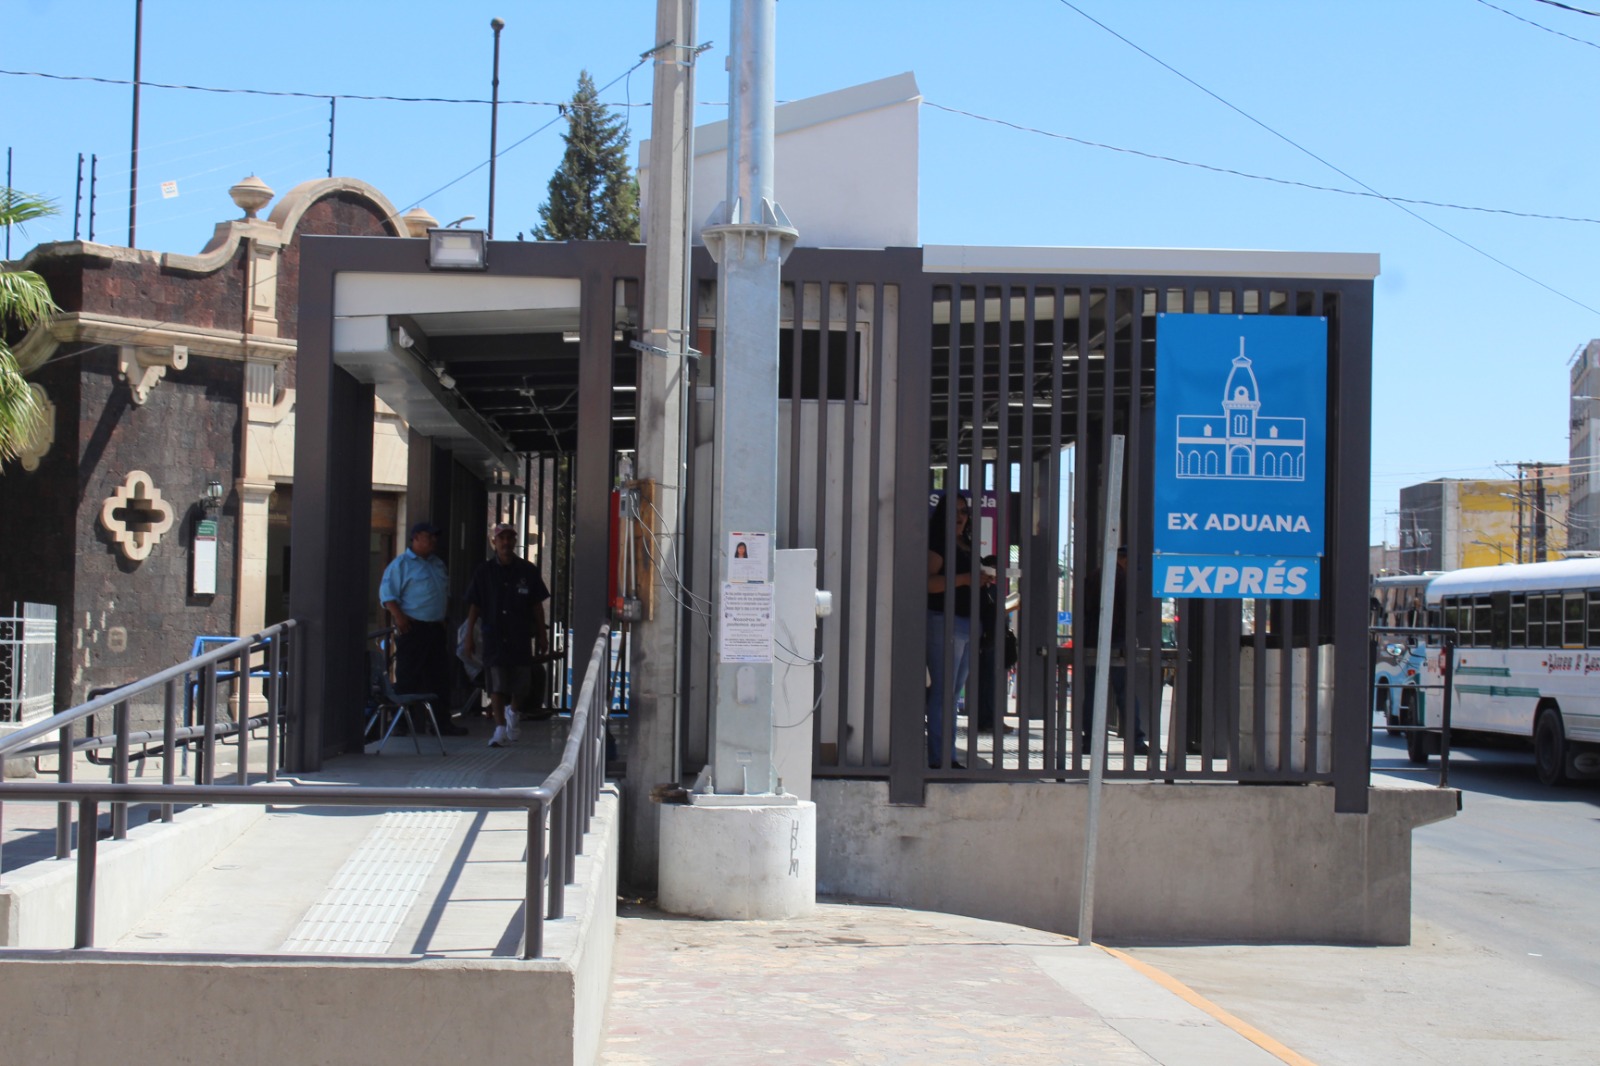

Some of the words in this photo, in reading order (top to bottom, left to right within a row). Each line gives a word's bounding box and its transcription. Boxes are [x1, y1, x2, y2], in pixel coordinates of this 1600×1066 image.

[1167, 512, 1199, 531] EX
[1204, 513, 1311, 533] ADUANA
[1163, 559, 1308, 595] EXPRÉS
